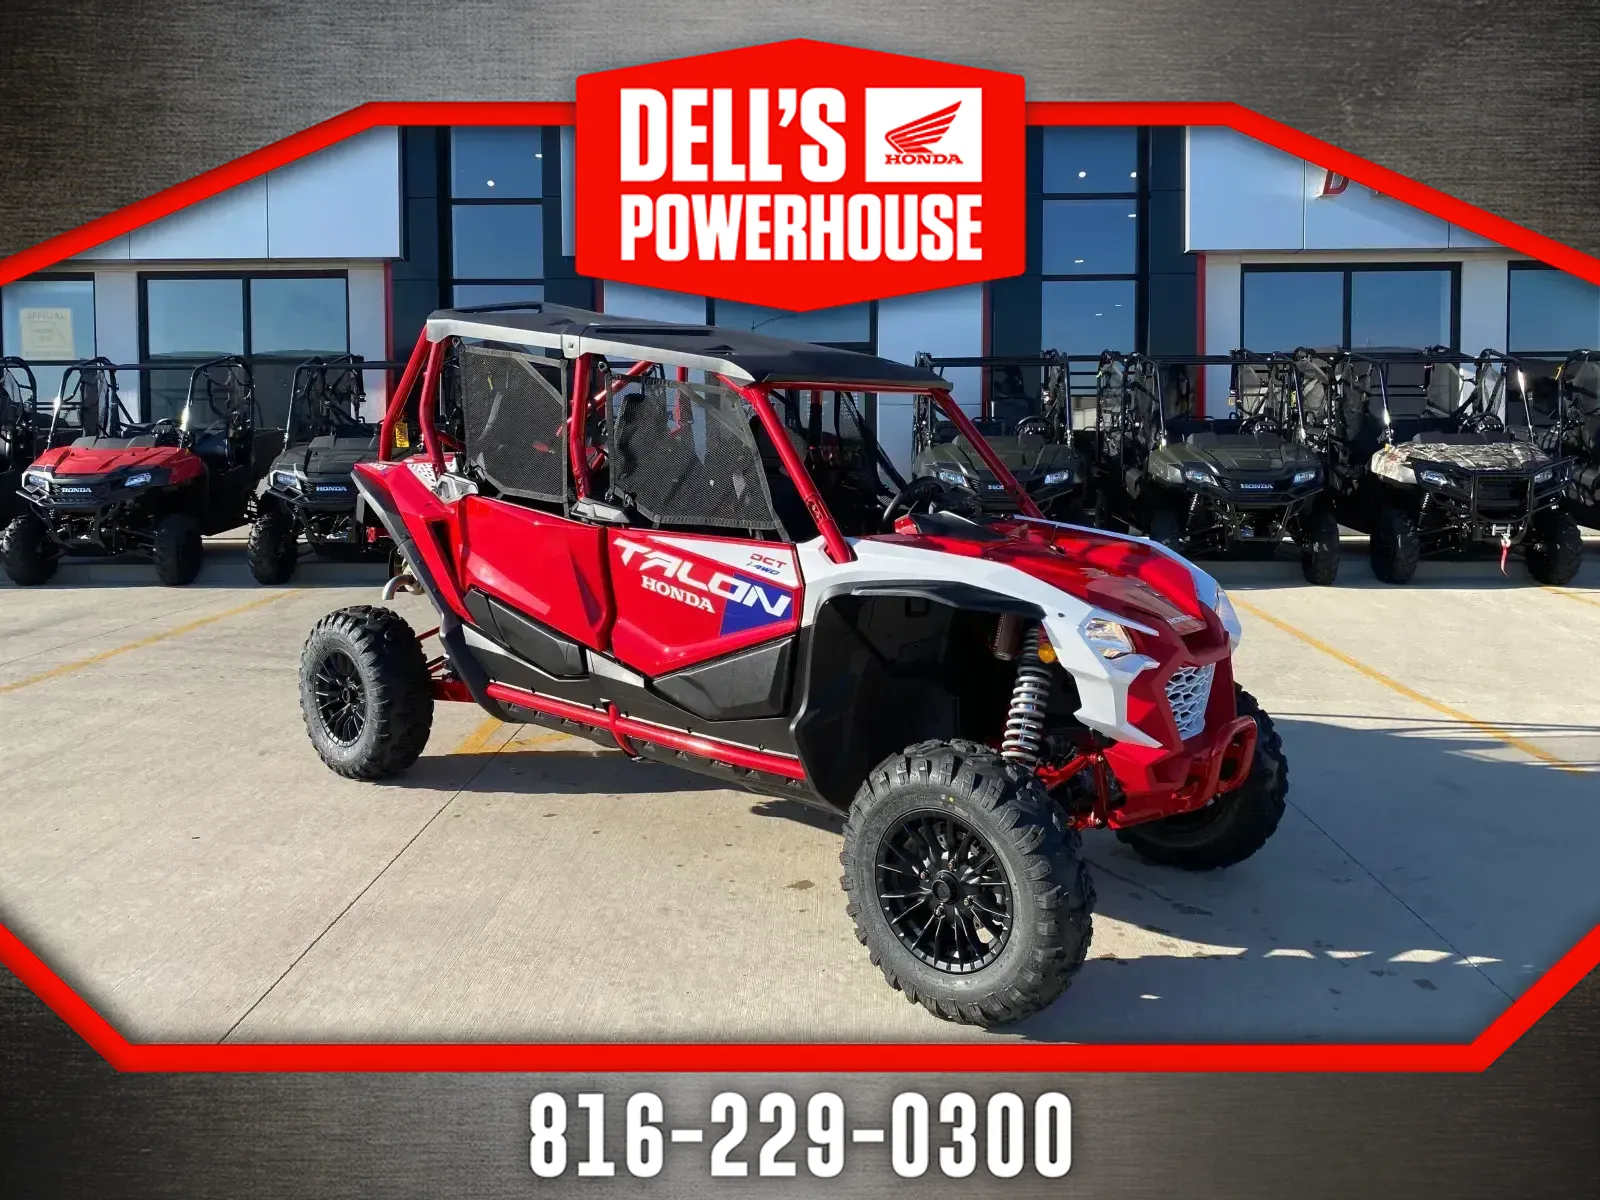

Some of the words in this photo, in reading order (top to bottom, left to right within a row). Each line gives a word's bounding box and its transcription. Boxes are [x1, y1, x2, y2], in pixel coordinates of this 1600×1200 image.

[613, 537, 791, 617] TALON
[750, 553, 787, 569] DCT
[641, 574, 715, 614] HONDA
